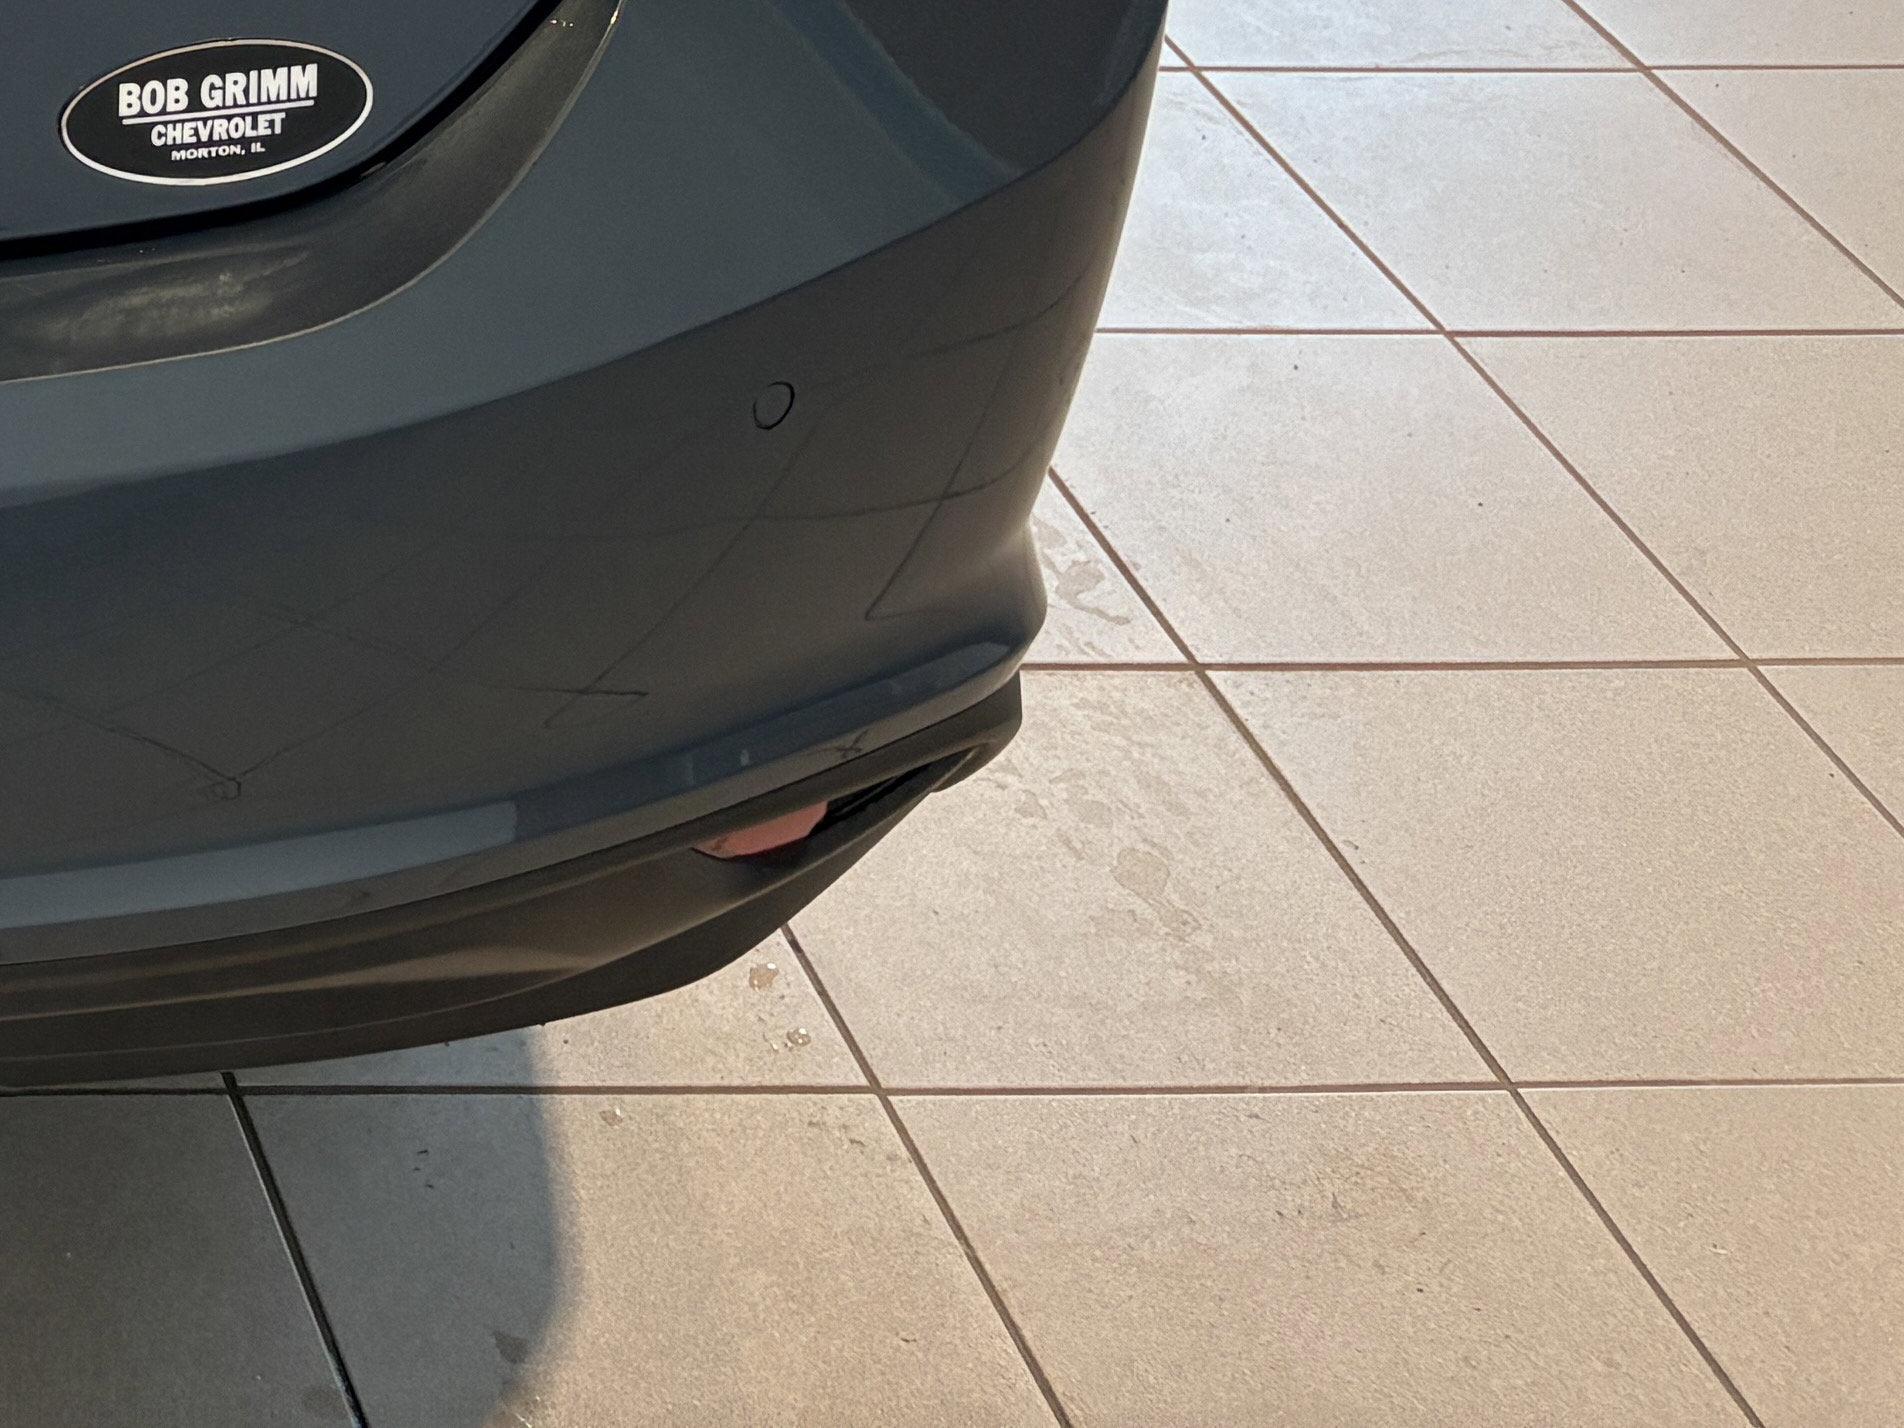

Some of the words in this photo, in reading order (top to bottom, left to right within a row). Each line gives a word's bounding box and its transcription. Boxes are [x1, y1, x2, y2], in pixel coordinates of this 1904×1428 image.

[118, 77, 189, 117] BOB
[200, 63, 318, 109] GRIMM
[150, 111, 286, 147] CHEVROLET
[171, 143, 245, 161] MORTON,
[251, 142, 266, 152] IL
